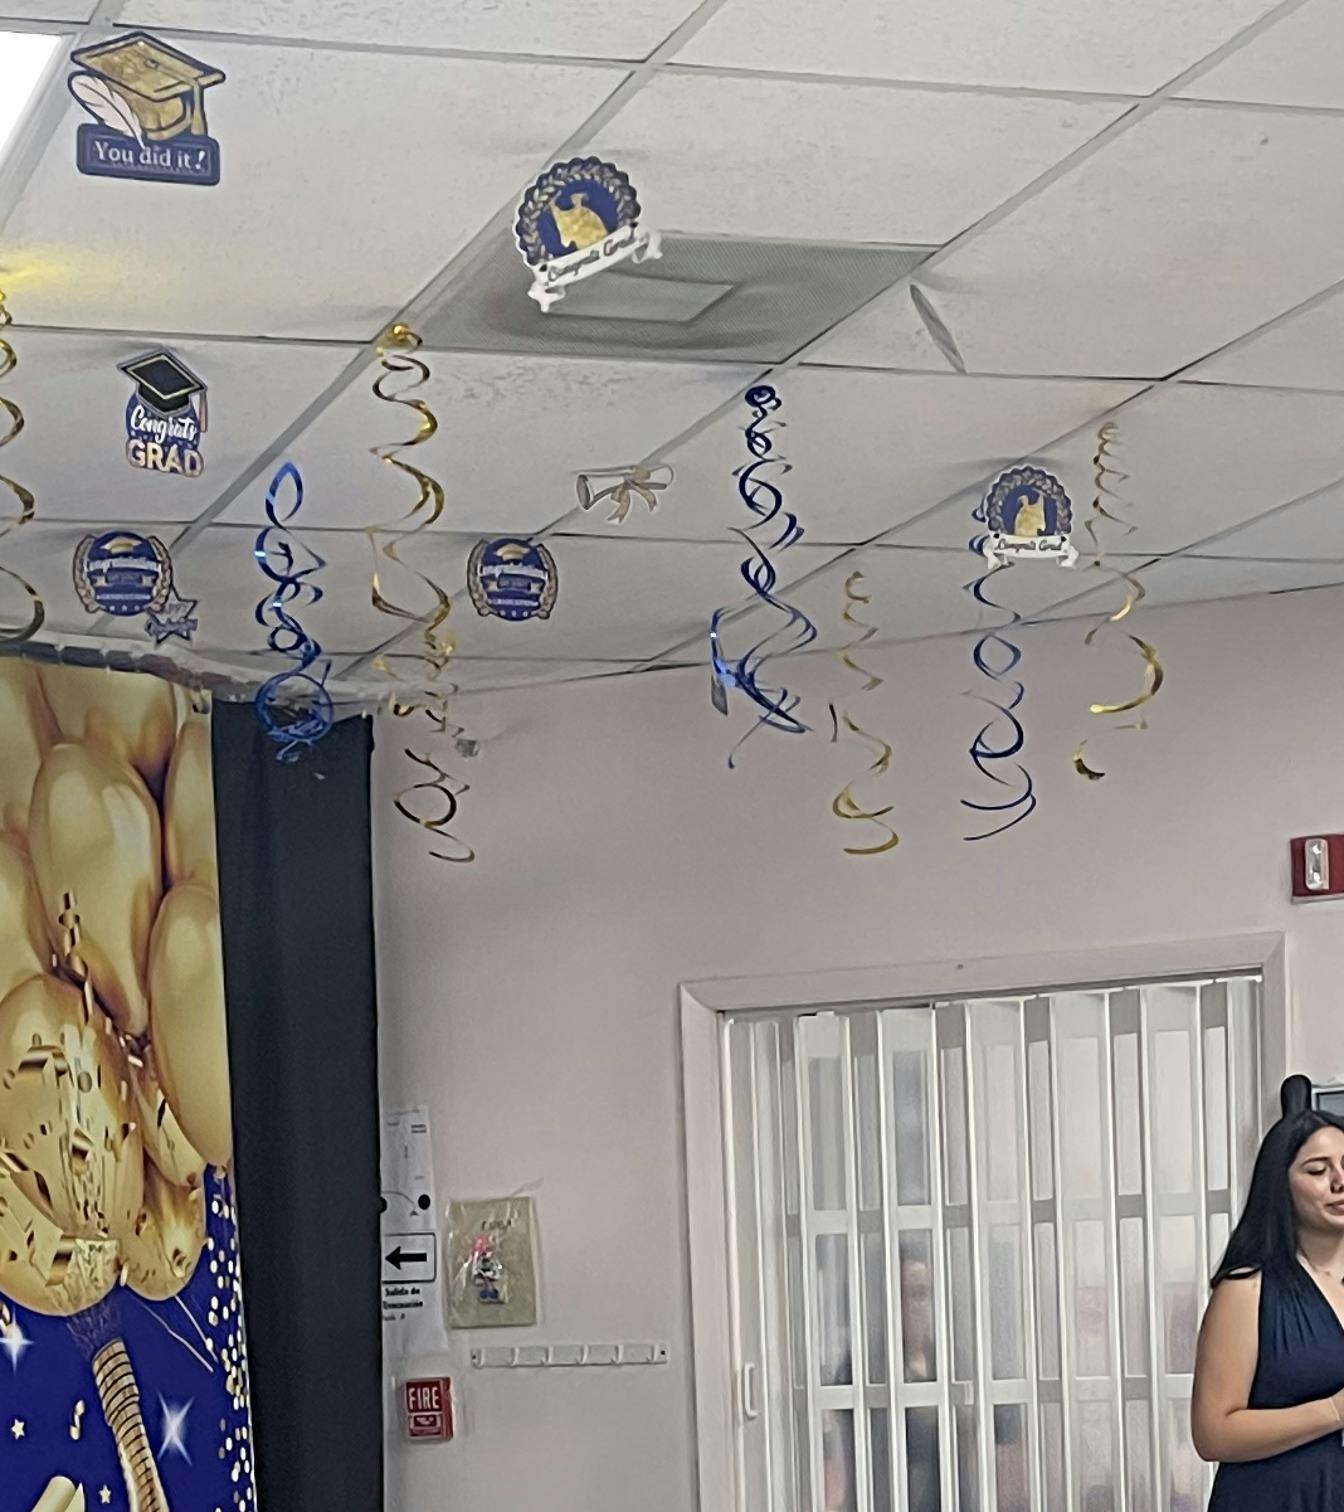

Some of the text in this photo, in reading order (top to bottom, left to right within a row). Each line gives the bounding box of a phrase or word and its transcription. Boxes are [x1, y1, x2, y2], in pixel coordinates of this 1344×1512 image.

[94, 141, 134, 163] You
[139, 145, 171, 167] did
[130, 404, 197, 444] Congrats
[126, 438, 204, 478] GRAD
[408, 1387, 440, 1410] FIRE
